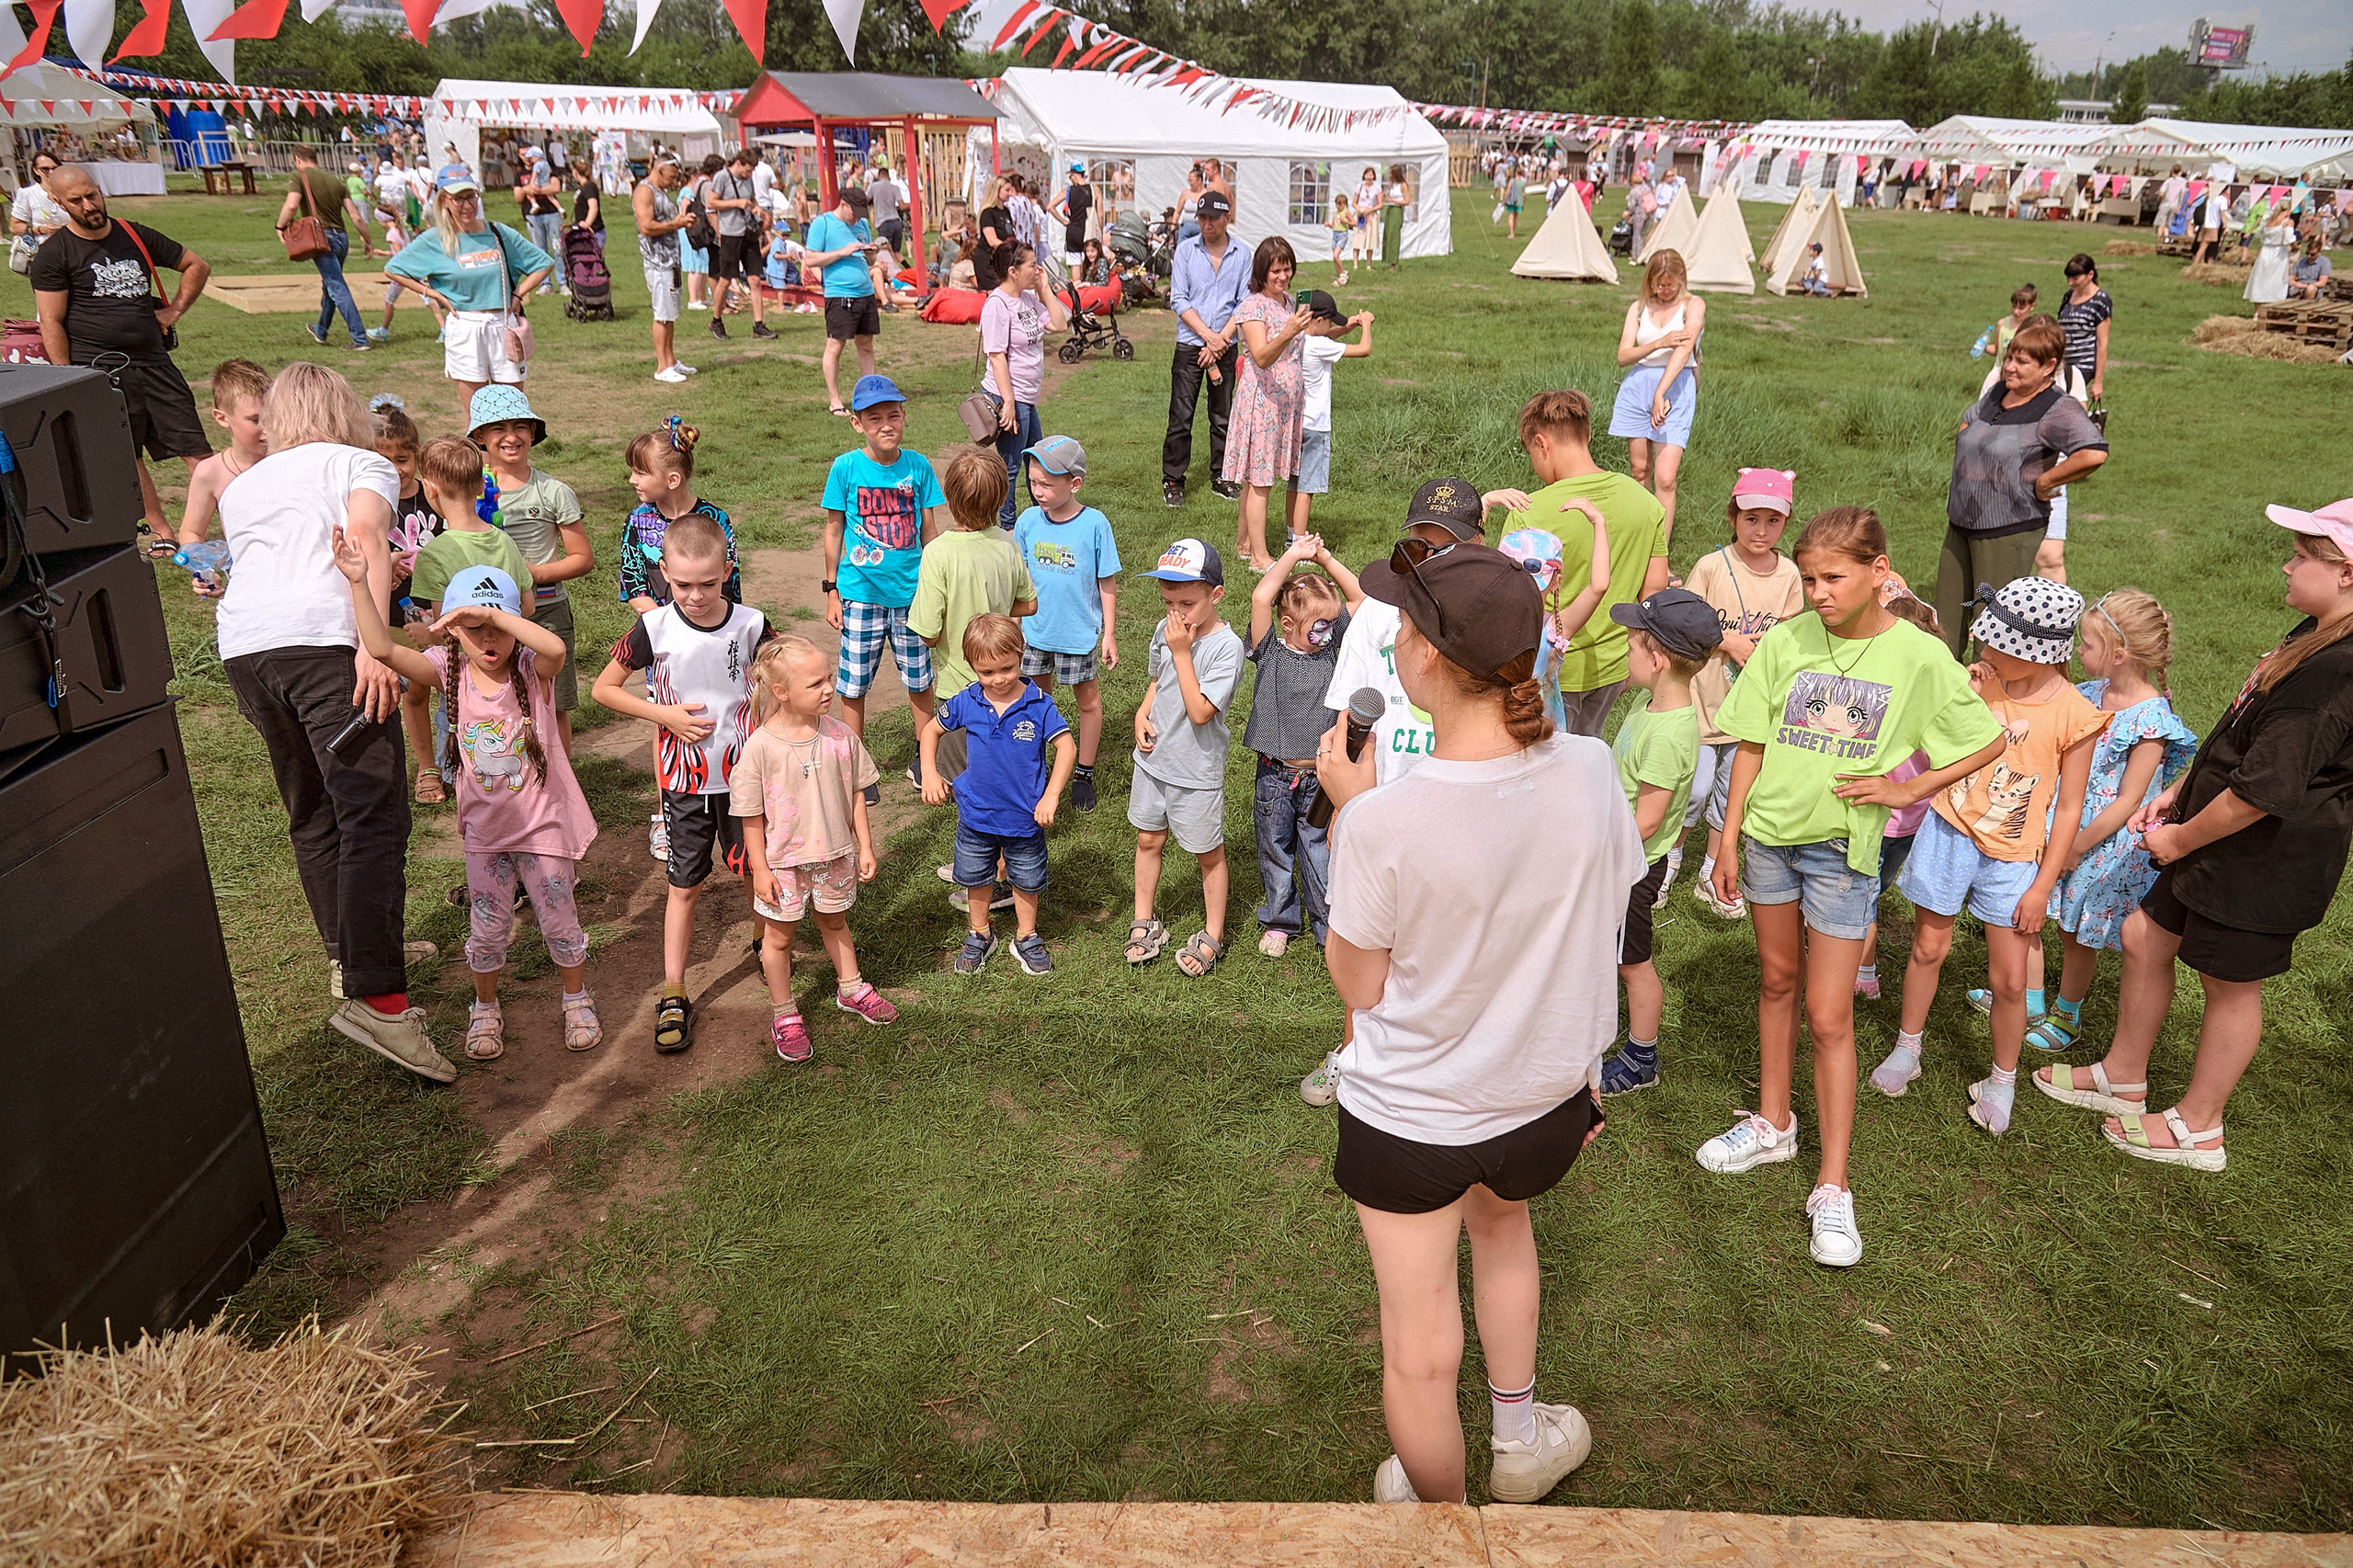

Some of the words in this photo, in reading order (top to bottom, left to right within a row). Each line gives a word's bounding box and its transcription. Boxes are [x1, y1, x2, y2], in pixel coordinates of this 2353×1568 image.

[1056, 567, 1076, 576] TRUCK
[472, 591, 504, 599] adidas
[1777, 727, 1833, 754] SWEET
[1837, 738, 1877, 759] TIME
